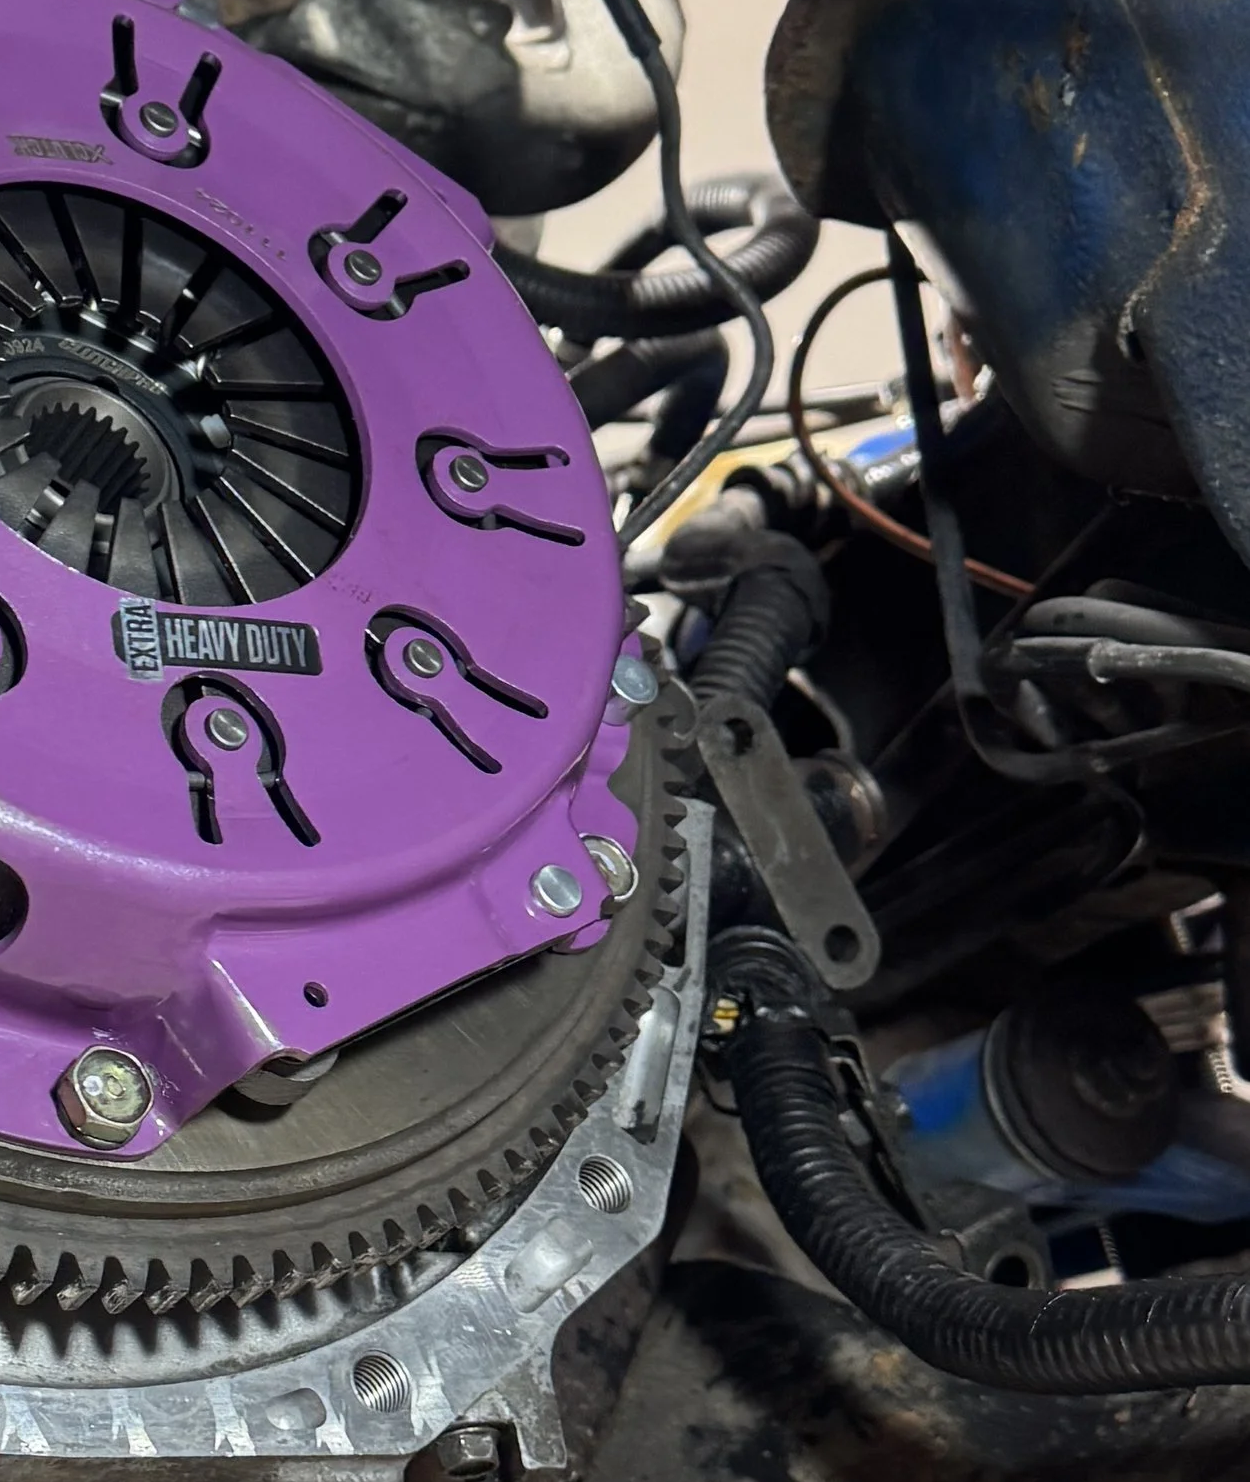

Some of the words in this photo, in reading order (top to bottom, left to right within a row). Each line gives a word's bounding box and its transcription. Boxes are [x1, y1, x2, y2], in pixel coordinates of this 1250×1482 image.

[126, 603, 160, 671] EXTRA
[165, 618, 240, 662] HEAVY
[245, 623, 307, 667] DUTY
